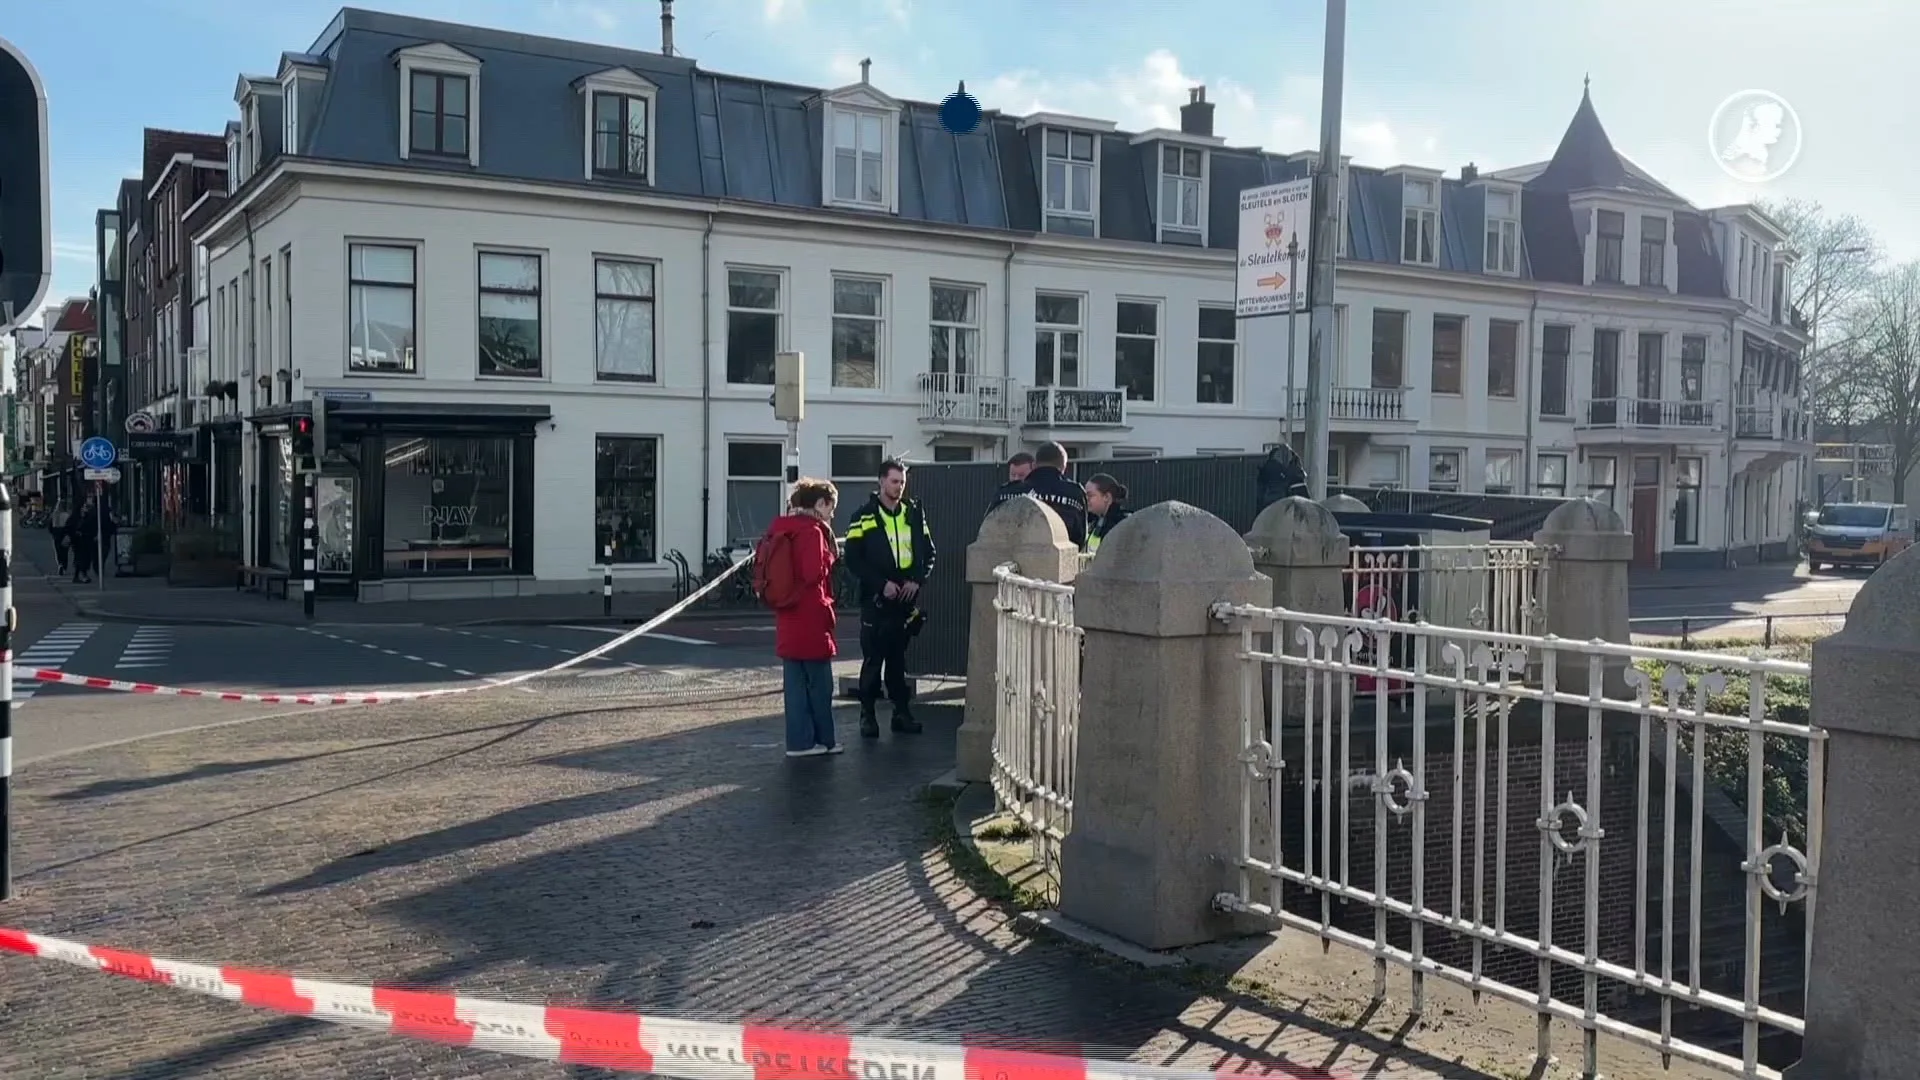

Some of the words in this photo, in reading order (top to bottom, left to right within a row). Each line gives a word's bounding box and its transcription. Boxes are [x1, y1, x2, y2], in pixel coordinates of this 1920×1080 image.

[1241, 197, 1272, 211] SLEUTELS
[1282, 192, 1308, 204] SLOTEN
[73, 334, 82, 394] HOTEL
[1028, 493, 1067, 505] OLITIE
